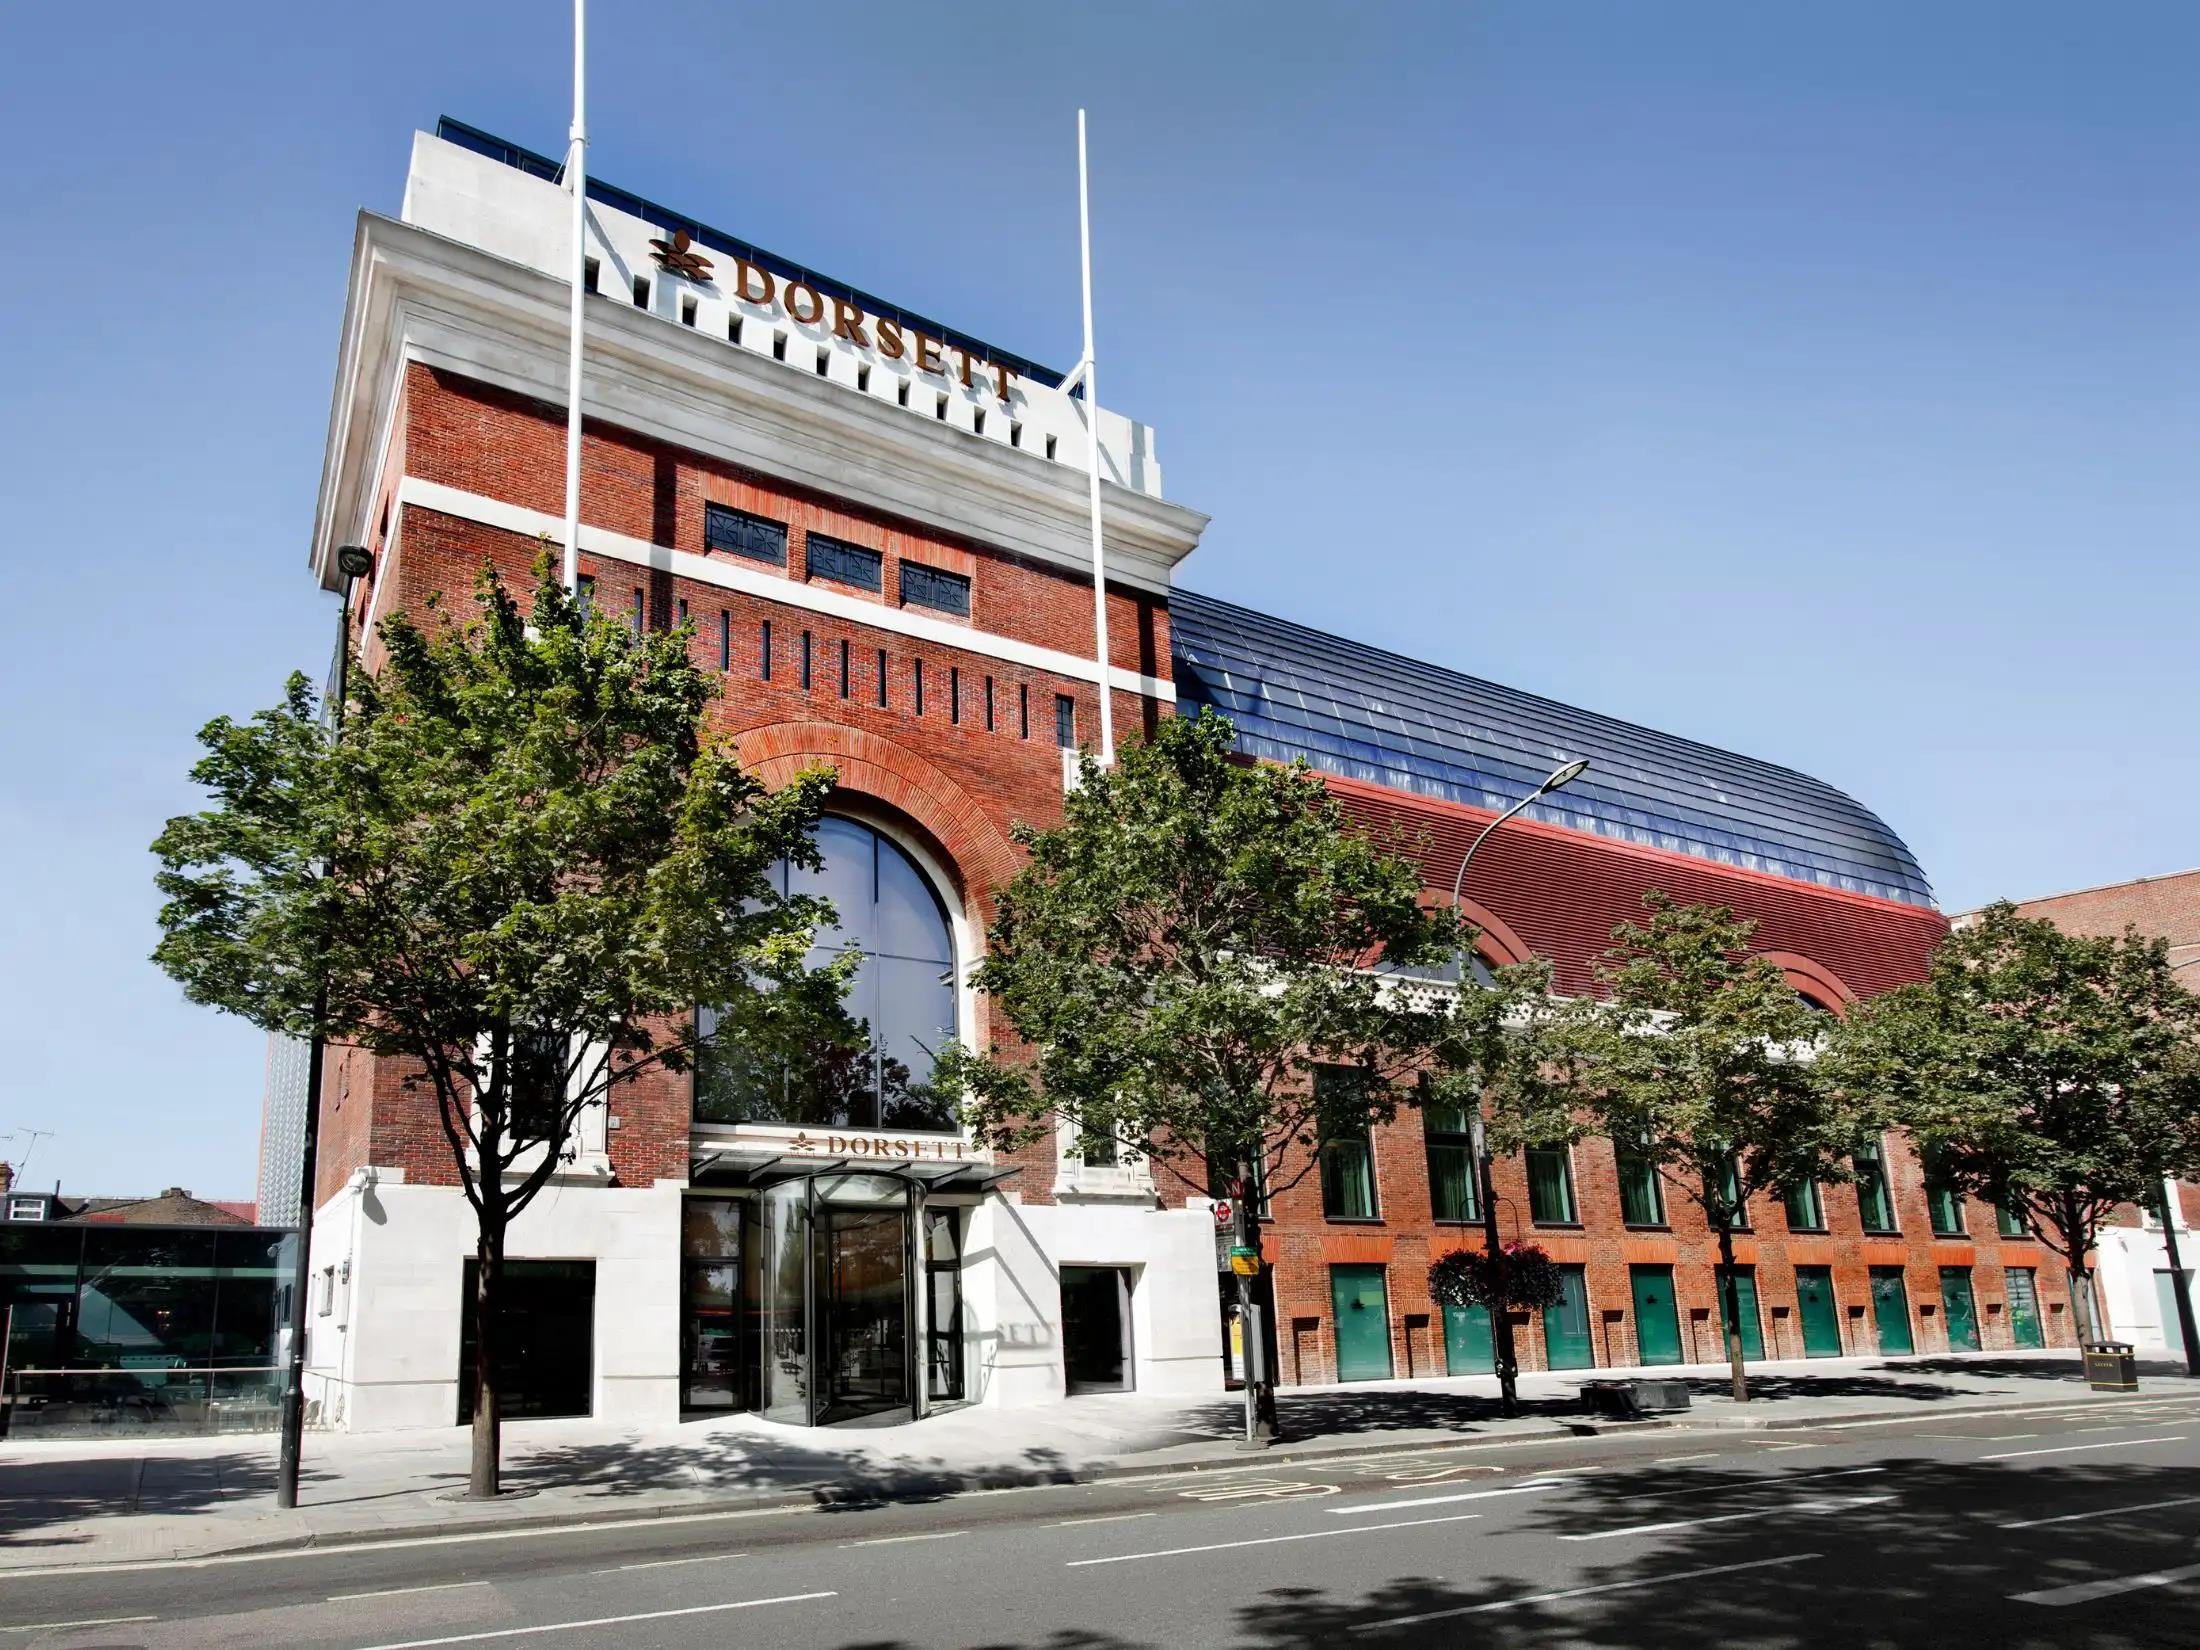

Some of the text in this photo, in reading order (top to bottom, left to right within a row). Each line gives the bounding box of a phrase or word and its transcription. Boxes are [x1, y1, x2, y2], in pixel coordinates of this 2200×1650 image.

[734, 258, 1018, 402] DORSETT
[828, 1136, 967, 1158] DORSETT
[1306, 1458, 1505, 1481] BUS
